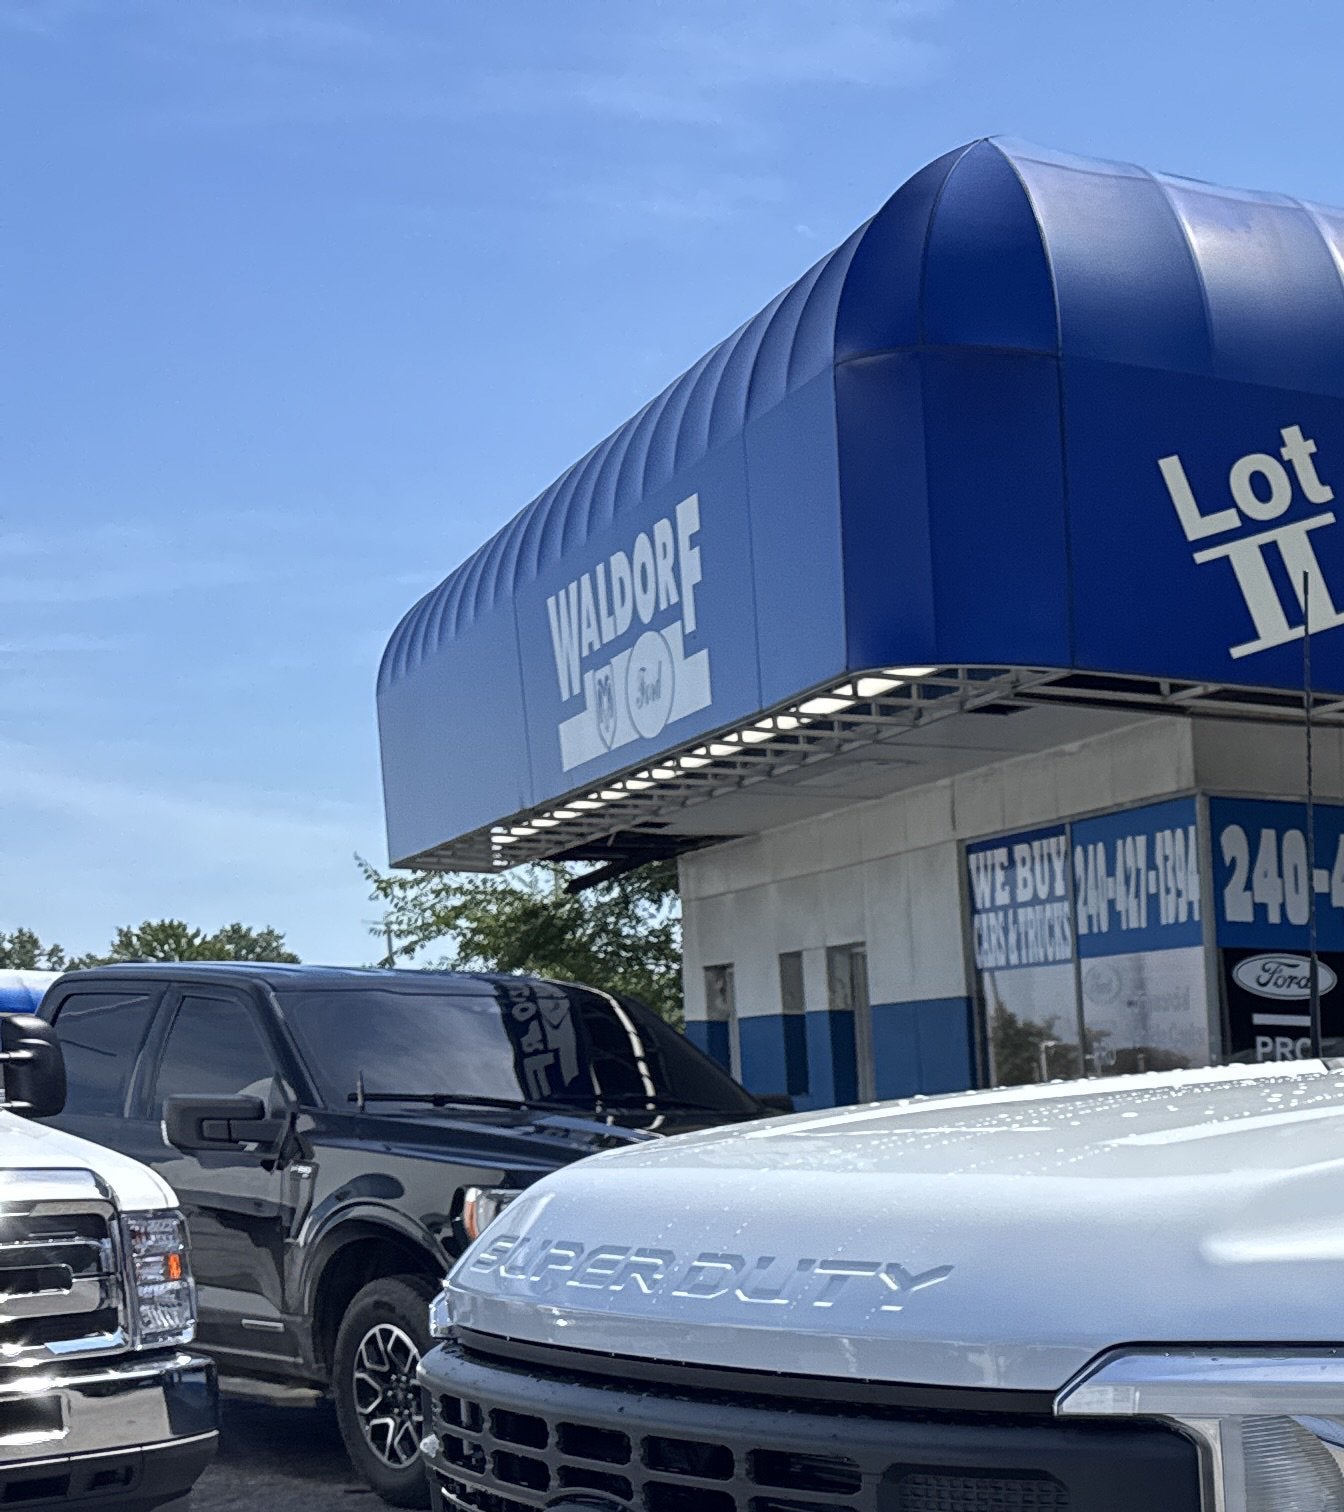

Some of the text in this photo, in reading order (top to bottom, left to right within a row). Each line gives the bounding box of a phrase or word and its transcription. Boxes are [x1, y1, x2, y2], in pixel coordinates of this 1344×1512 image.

[1157, 425, 1334, 541] Lot
[547, 492, 703, 702] WALDORF
[968, 835, 1067, 909] WE BUY
[1074, 825, 1200, 935] 240-427-1394
[469, 1234, 957, 1312] SUPER DUTY
